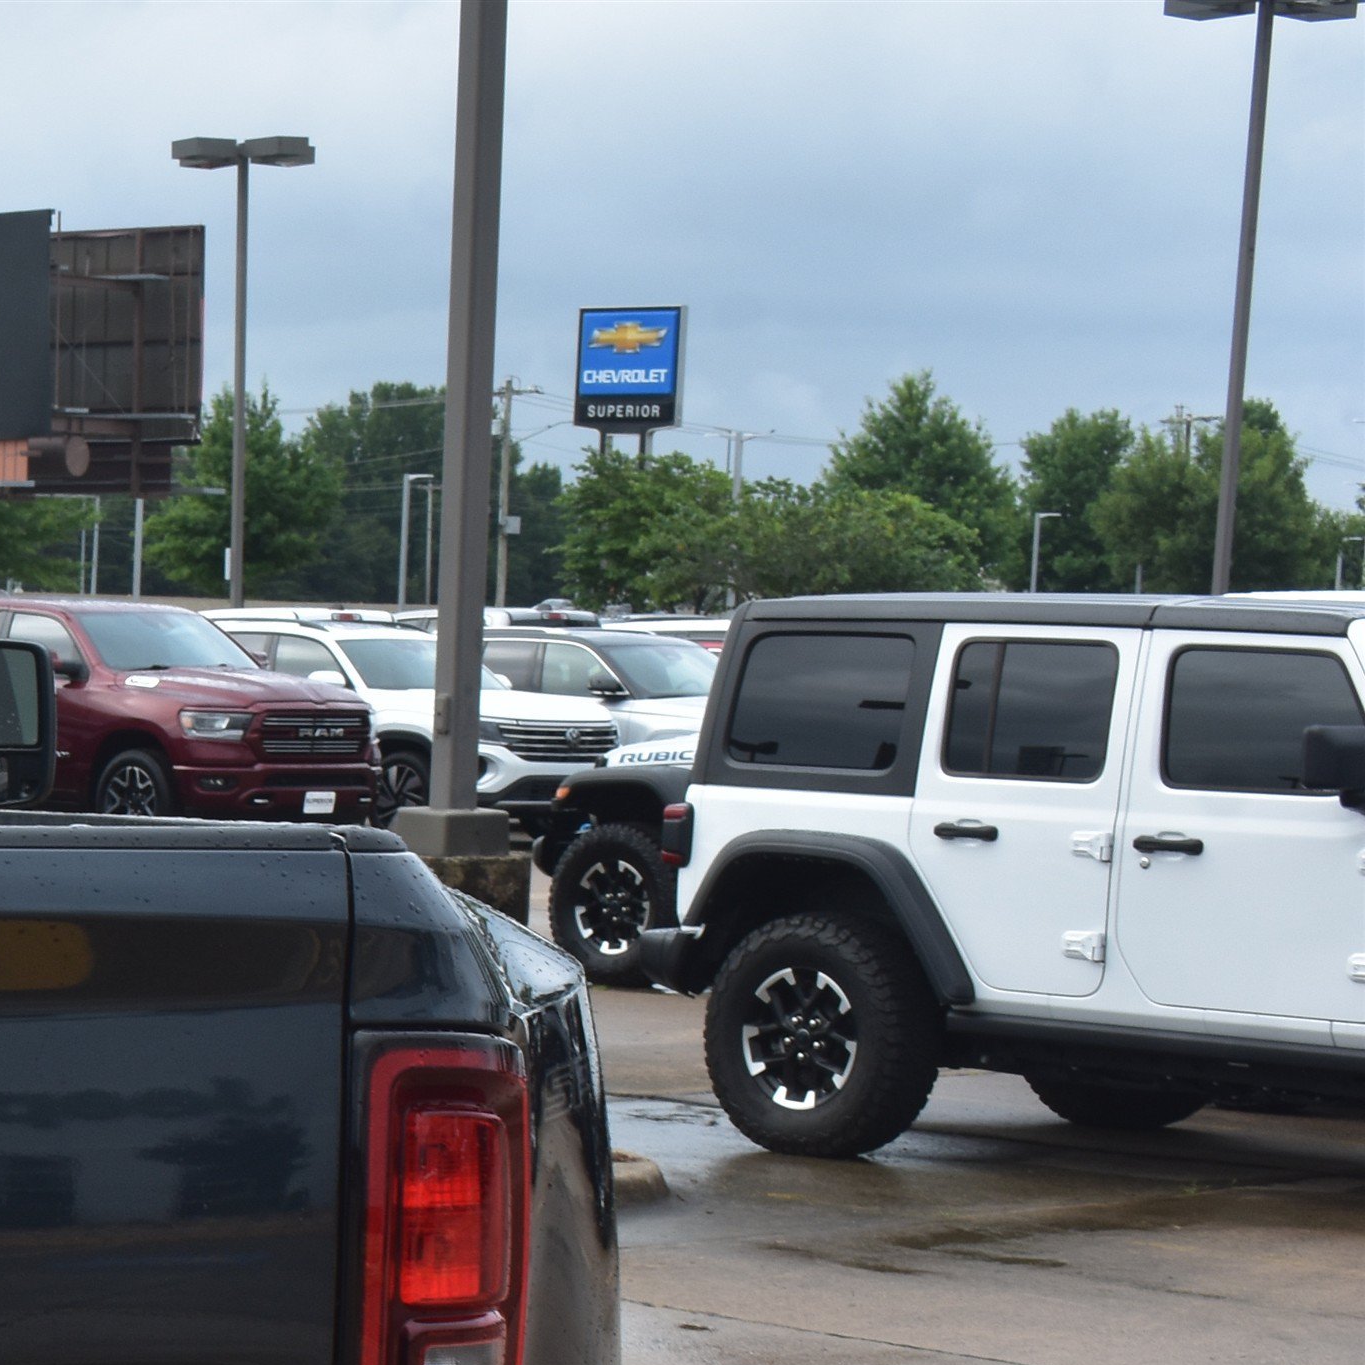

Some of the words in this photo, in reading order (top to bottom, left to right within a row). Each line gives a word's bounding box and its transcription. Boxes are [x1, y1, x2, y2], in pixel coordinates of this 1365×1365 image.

[583, 369, 668, 384] CHEVROLET
[587, 404, 661, 418] SUPERIOR
[619, 751, 694, 764] RUBIC
